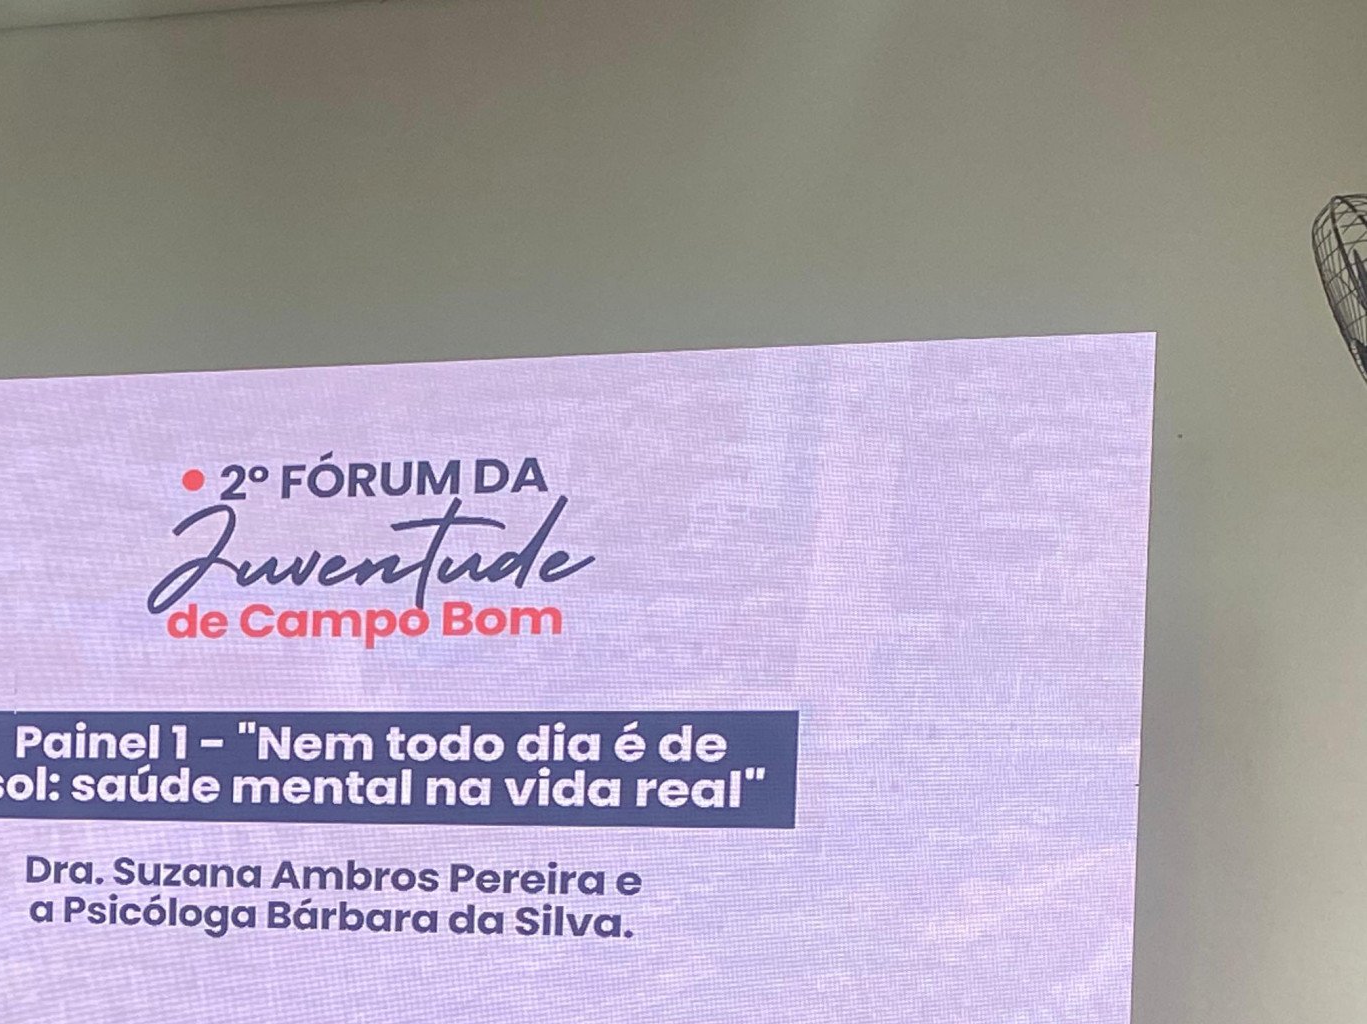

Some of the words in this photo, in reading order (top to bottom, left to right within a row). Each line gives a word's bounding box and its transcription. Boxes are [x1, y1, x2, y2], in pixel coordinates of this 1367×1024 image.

[281, 450, 461, 500] FÓRUM
[474, 457, 549, 494] DA
[147, 496, 596, 615] Juventude
[167, 602, 228, 639] de
[239, 603, 430, 649] Campo
[442, 600, 563, 637] Bom
[16, 721, 160, 760] Painel
[171, 724, 187, 760] 1
[238, 721, 374, 761] "Nem
[385, 725, 505, 762] todo
[516, 721, 601, 763] dia
[614, 720, 646, 763] é
[658, 724, 728, 763] de
[71, 763, 221, 804] saúde
[232, 768, 412, 805] mental
[426, 777, 492, 806] na
[504, 766, 621, 807] vida
[636, 767, 766, 808] real"
[26, 855, 105, 885] Dra.
[113, 856, 262, 889] Suzana
[270, 859, 440, 893] Ambros
[449, 861, 605, 896] Pereira
[615, 871, 643, 896] e
[29, 900, 54, 924] a
[64, 893, 257, 939] Psicóloga
[267, 897, 439, 934] Bárbara
[448, 904, 505, 936] da
[515, 902, 634, 939] Silva.
